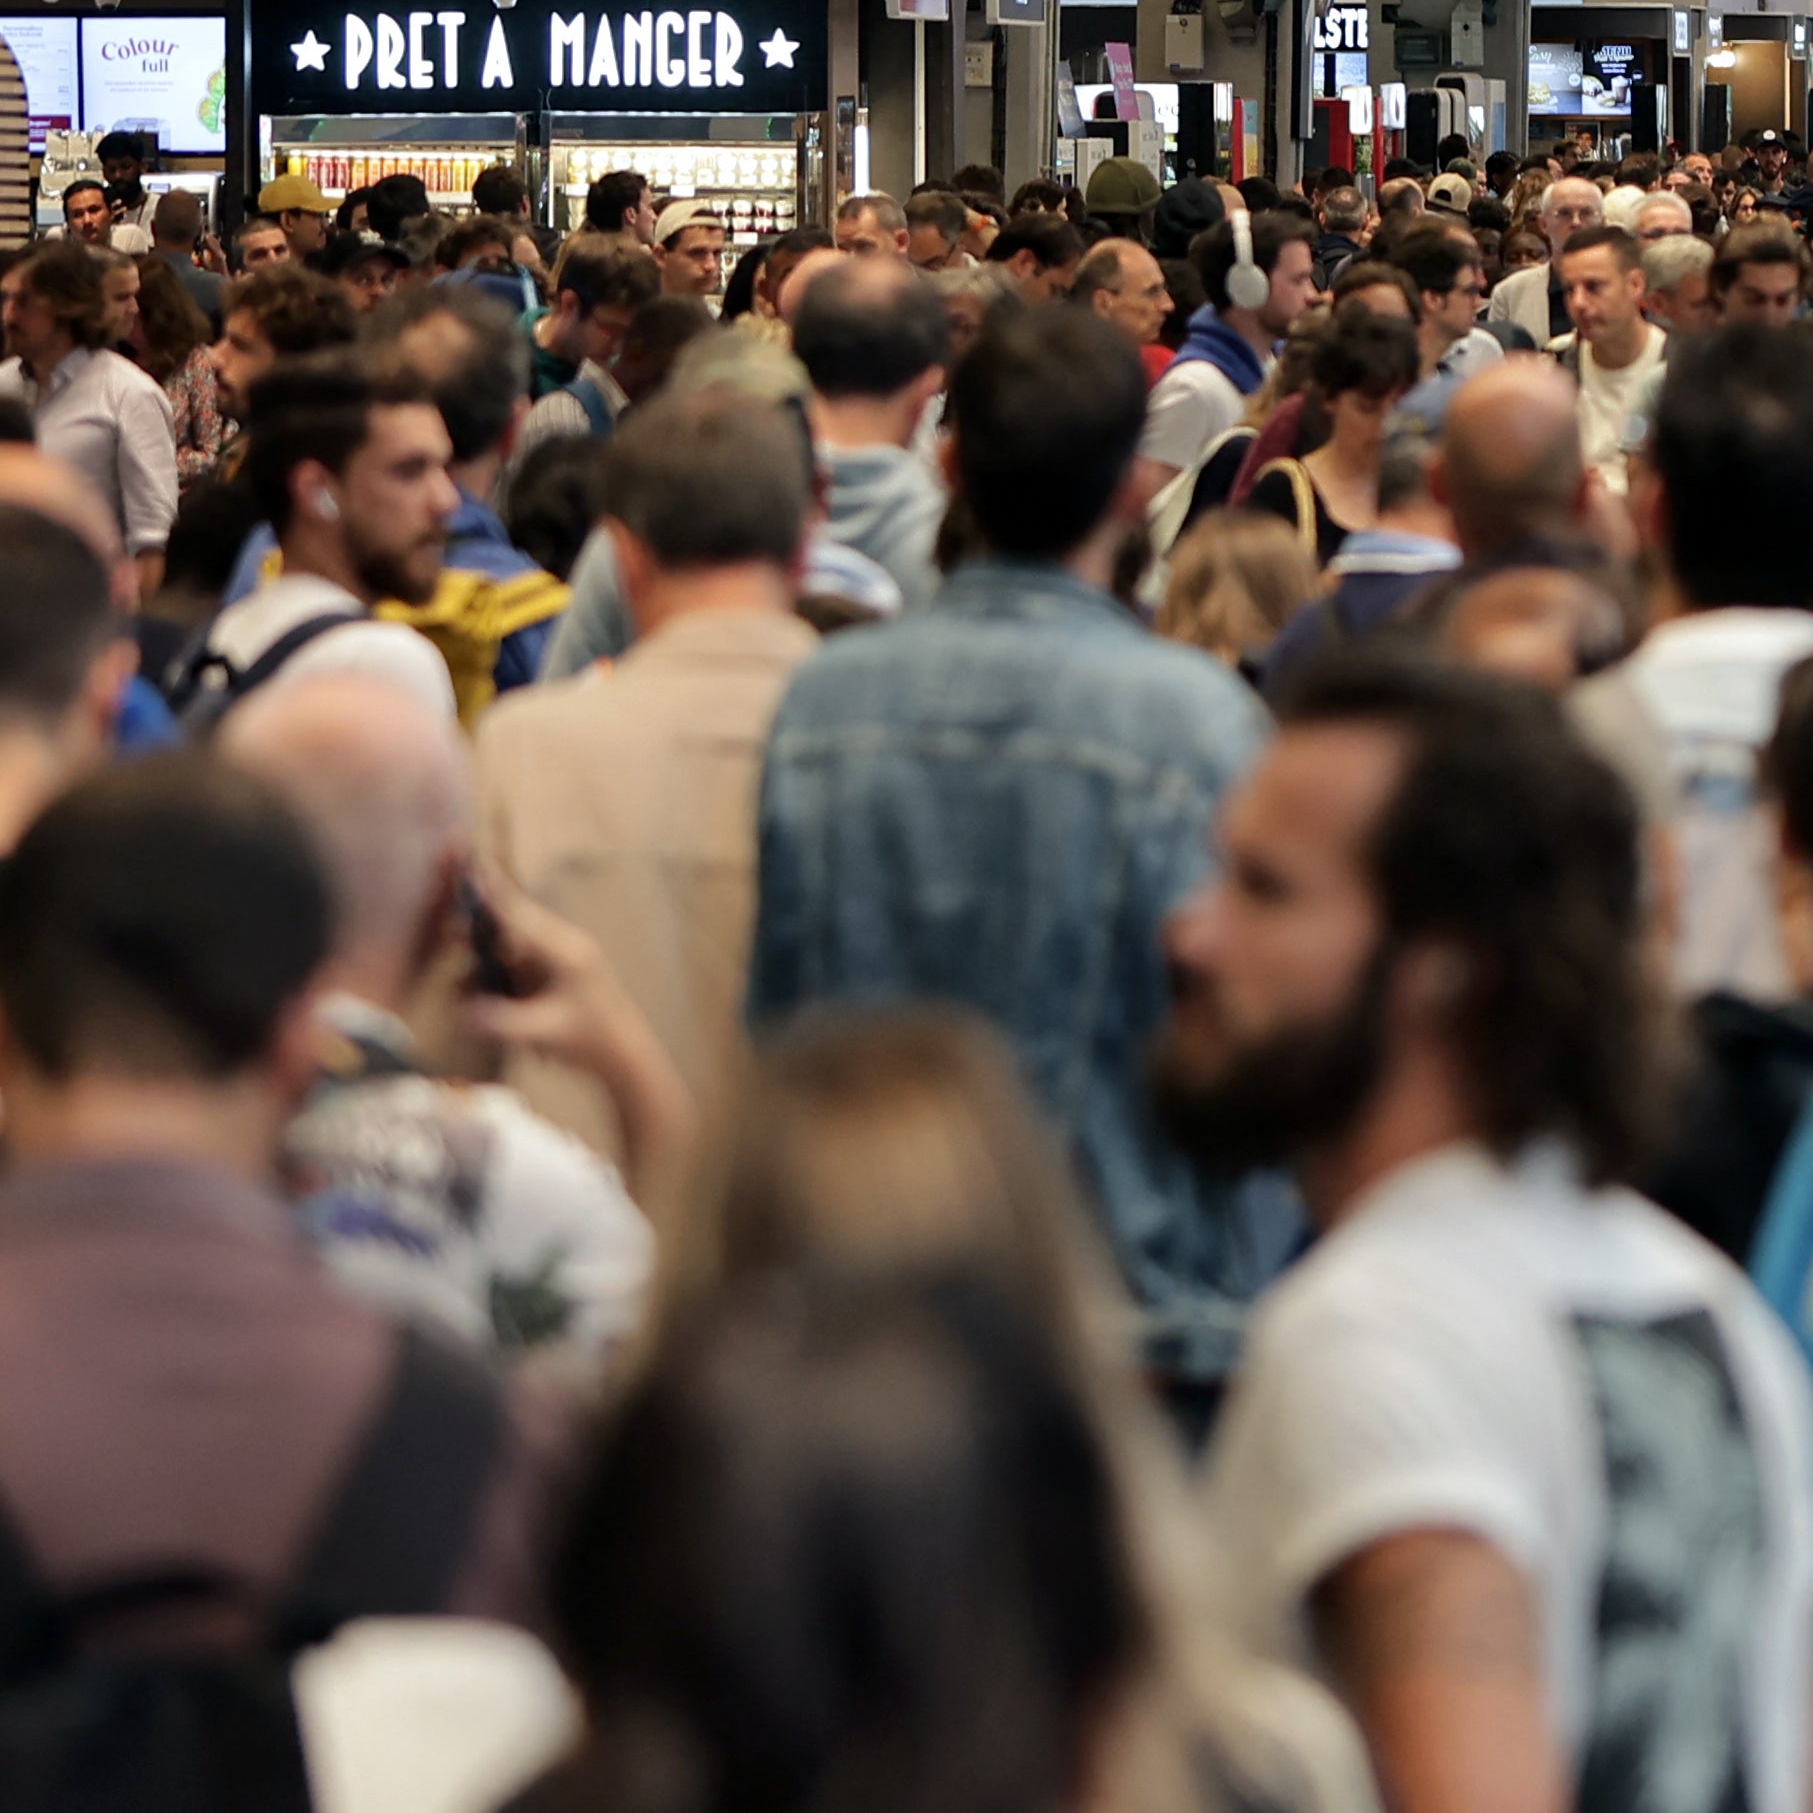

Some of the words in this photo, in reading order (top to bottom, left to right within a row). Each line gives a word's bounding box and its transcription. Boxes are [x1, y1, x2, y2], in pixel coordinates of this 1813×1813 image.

[101, 36, 179, 61] Colour
[345, 11, 465, 90] PRET
[482, 14, 515, 89] A
[548, 11, 744, 89] MANGER
[142, 58, 169, 73] full
